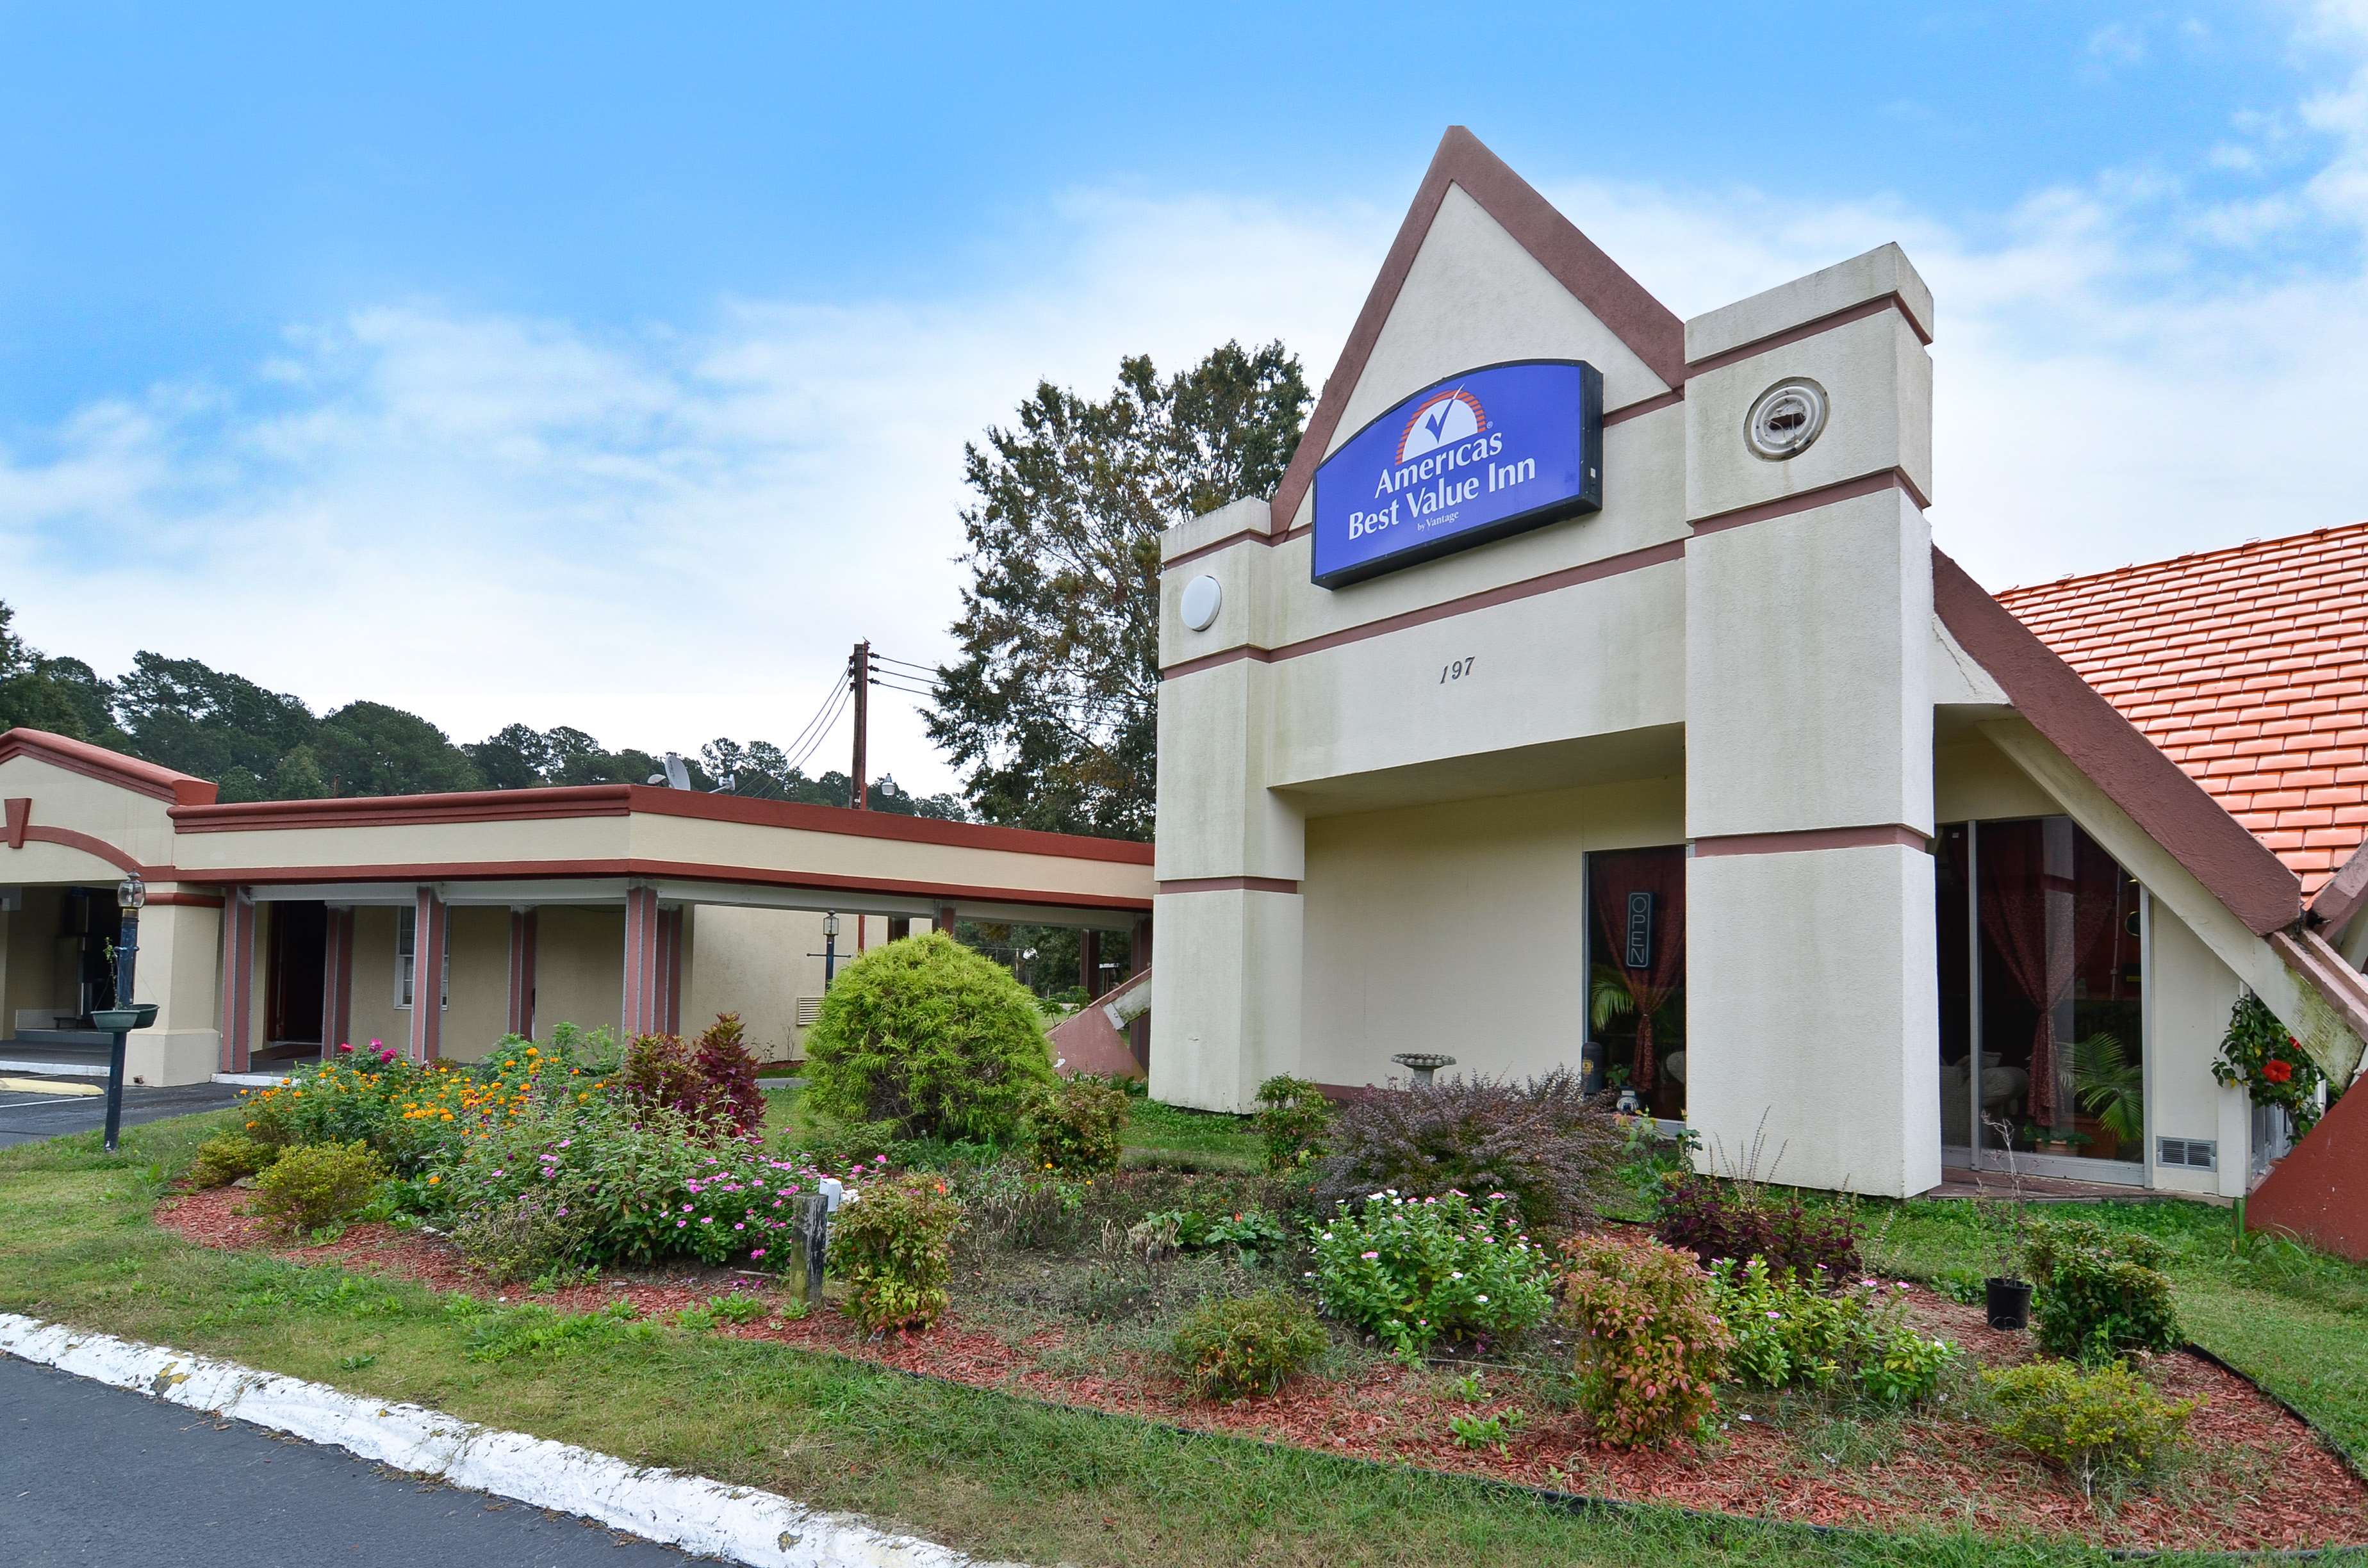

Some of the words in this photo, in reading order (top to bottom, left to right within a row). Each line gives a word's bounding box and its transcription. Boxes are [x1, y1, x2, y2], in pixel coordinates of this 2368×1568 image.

[1374, 432, 1503, 498] Americas
[1348, 498, 1399, 540] Best
[1405, 476, 1479, 519] Value
[1488, 457, 1536, 493] Inn
[1417, 522, 1426, 532] by
[1426, 511, 1459, 528] Vantage
[1440, 656, 1476, 685] 197
[1631, 896, 1647, 963] OPEN
